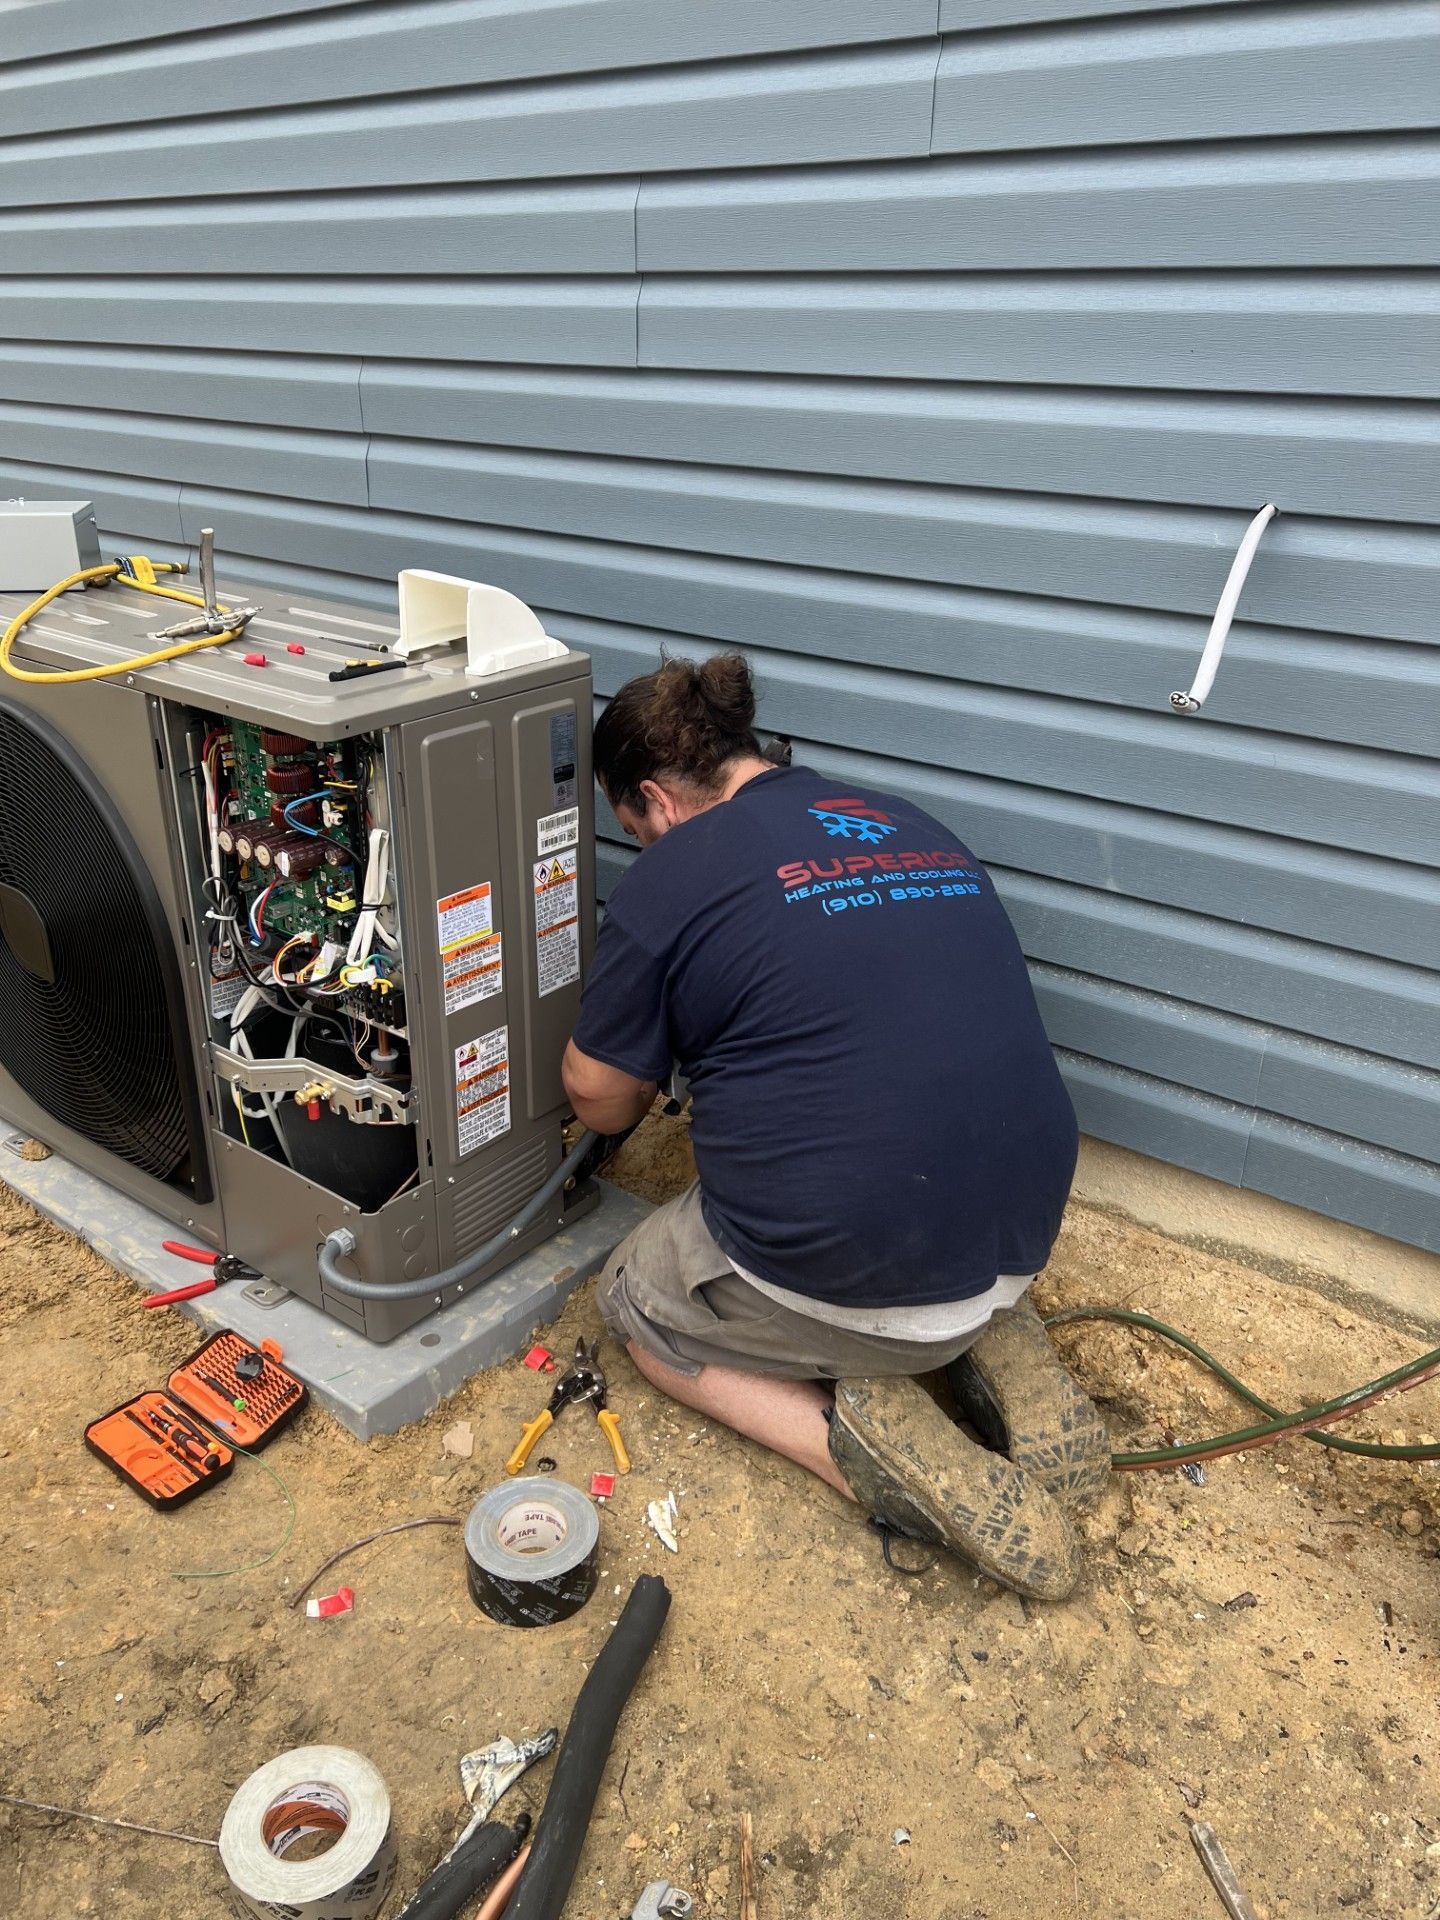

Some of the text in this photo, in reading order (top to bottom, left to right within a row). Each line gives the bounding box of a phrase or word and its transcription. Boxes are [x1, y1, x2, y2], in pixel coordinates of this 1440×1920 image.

[785, 877, 864, 903] HEATING
[871, 872, 905, 885] AND
[909, 869, 964, 880] COOLING
[822, 883, 981, 916] (910) 890-2812
[460, 938, 490, 955] WARNING
[453, 961, 500, 985] AVERTISSEMENT
[525, 1514, 544, 1522] TAPE
[517, 1528, 537, 1538] TAPE
